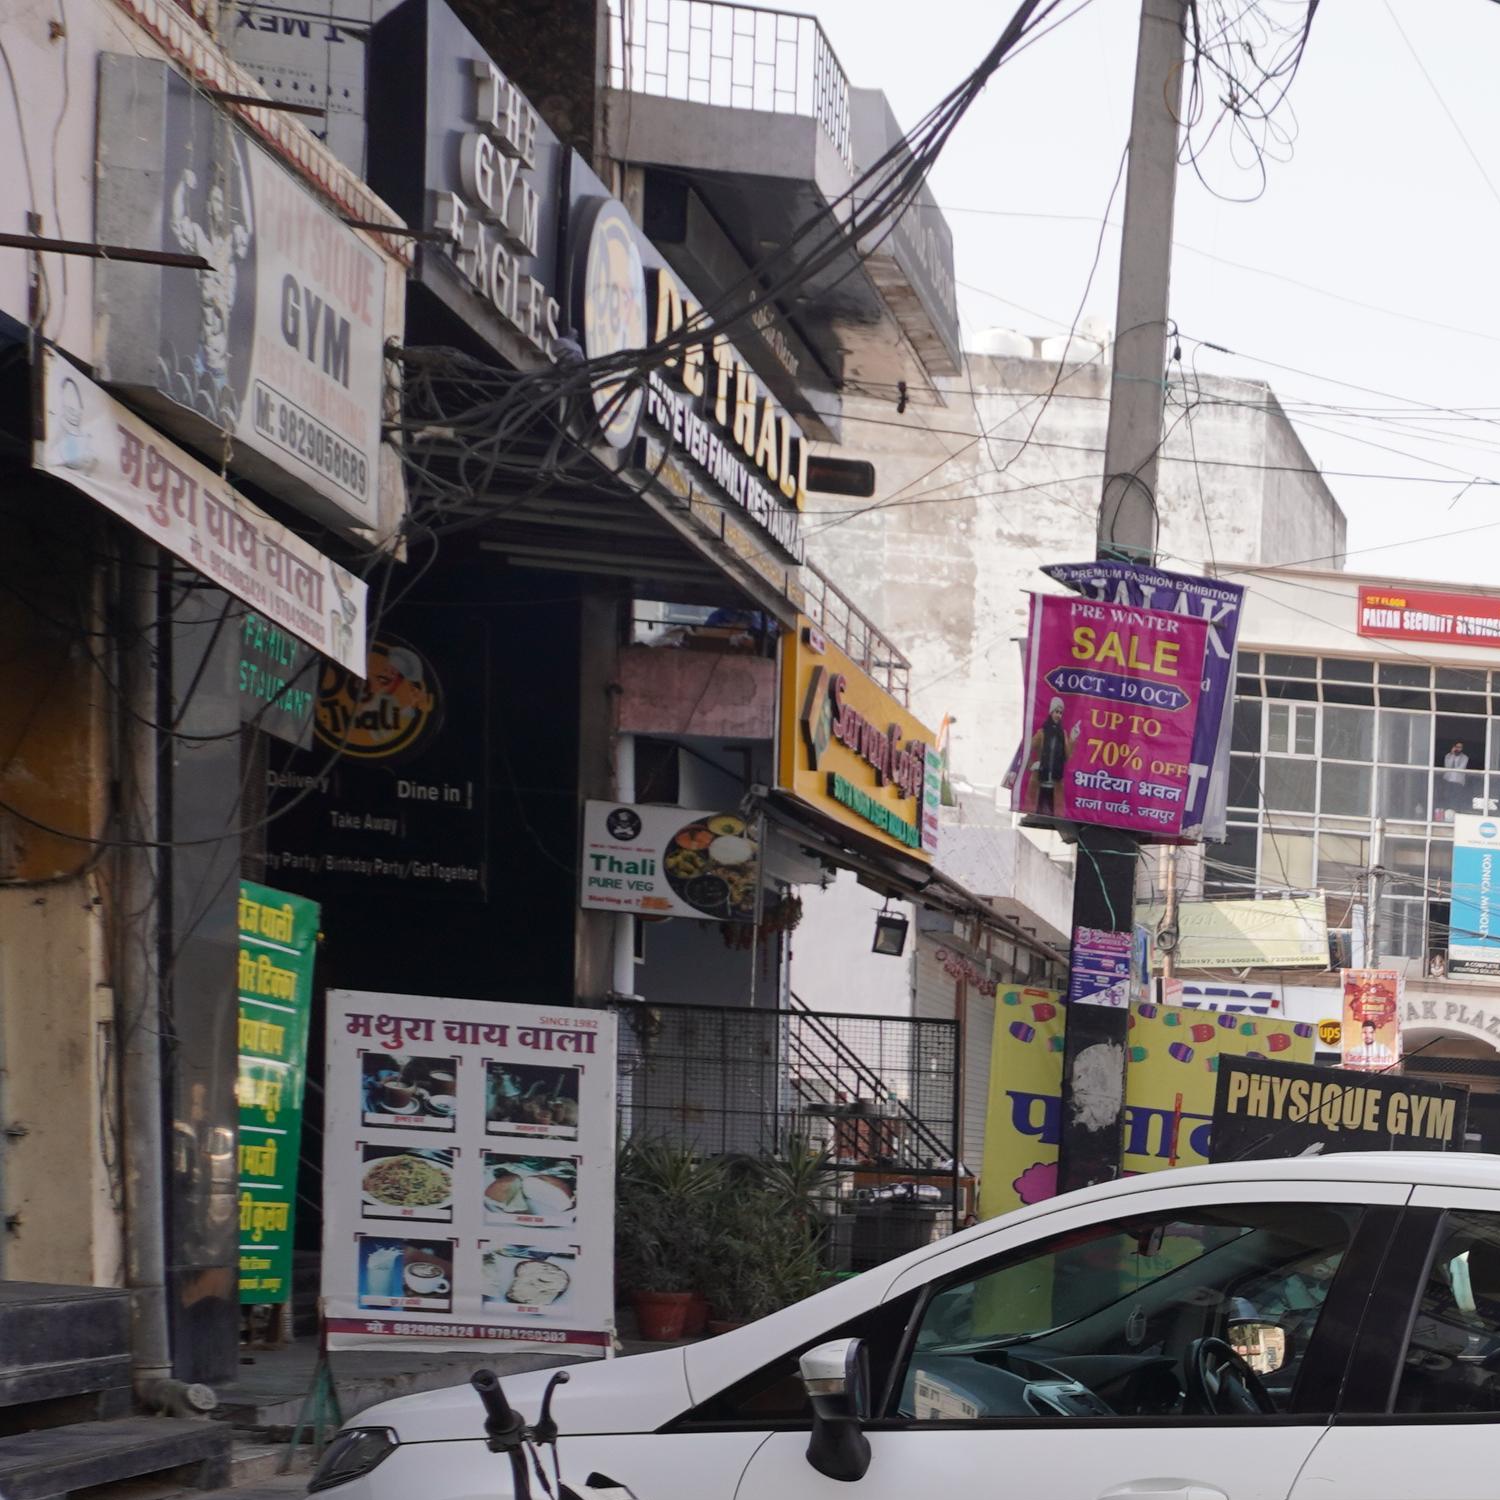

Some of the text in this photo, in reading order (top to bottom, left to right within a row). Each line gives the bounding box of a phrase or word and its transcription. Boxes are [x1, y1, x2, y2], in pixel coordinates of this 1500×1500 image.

[474, 59, 539, 171] THE
[462, 132, 540, 257] GYM
[257, 176, 374, 328] PHYSIQUE
[447, 190, 560, 364] EAGLES
[281, 272, 350, 391] GYM
[712, 330, 808, 513] THALI
[681, 409, 708, 467] VEG
[707, 435, 748, 511] FAMILY
[117, 423, 327, 617] मथुरा चाय वाला
[1071, 568, 1238, 603] PREMIUM FASHION EXHIBITION
[1070, 602, 1180, 635] PRE WINTER
[1402, 611, 1454, 634] SECURITY
[243, 612, 297, 669] FAMILY
[1071, 626, 1181, 676] SALE
[1054, 675, 1182, 708] 4 OCT 19 OCT
[320, 700, 401, 734] Thali
[1090, 708, 1162, 737] UP TO
[1087, 738, 1188, 779] 70% OFF
[266, 770, 461, 803] Delivery Dine in
[1074, 769, 1182, 802] भाटिया भवन
[330, 810, 398, 836] Take Away
[1075, 796, 1103, 811] राजा
[1138, 806, 1176, 824] जयपुर
[375, 859, 405, 879] Party
[412, 861, 432, 878] Get
[432, 863, 479, 883] Together
[589, 853, 656, 877] Thali
[1480, 853, 1493, 895] KONICA
[587, 877, 655, 892] PURE VEG
[344, 1012, 599, 1055] मथुरा चाय वाला
[539, 1015, 599, 1030] SINCE 1982
[1320, 1024, 1341, 1043] ups
[1227, 1071, 1381, 1133] PHYSIQUE
[1386, 1092, 1457, 1142] GYM
